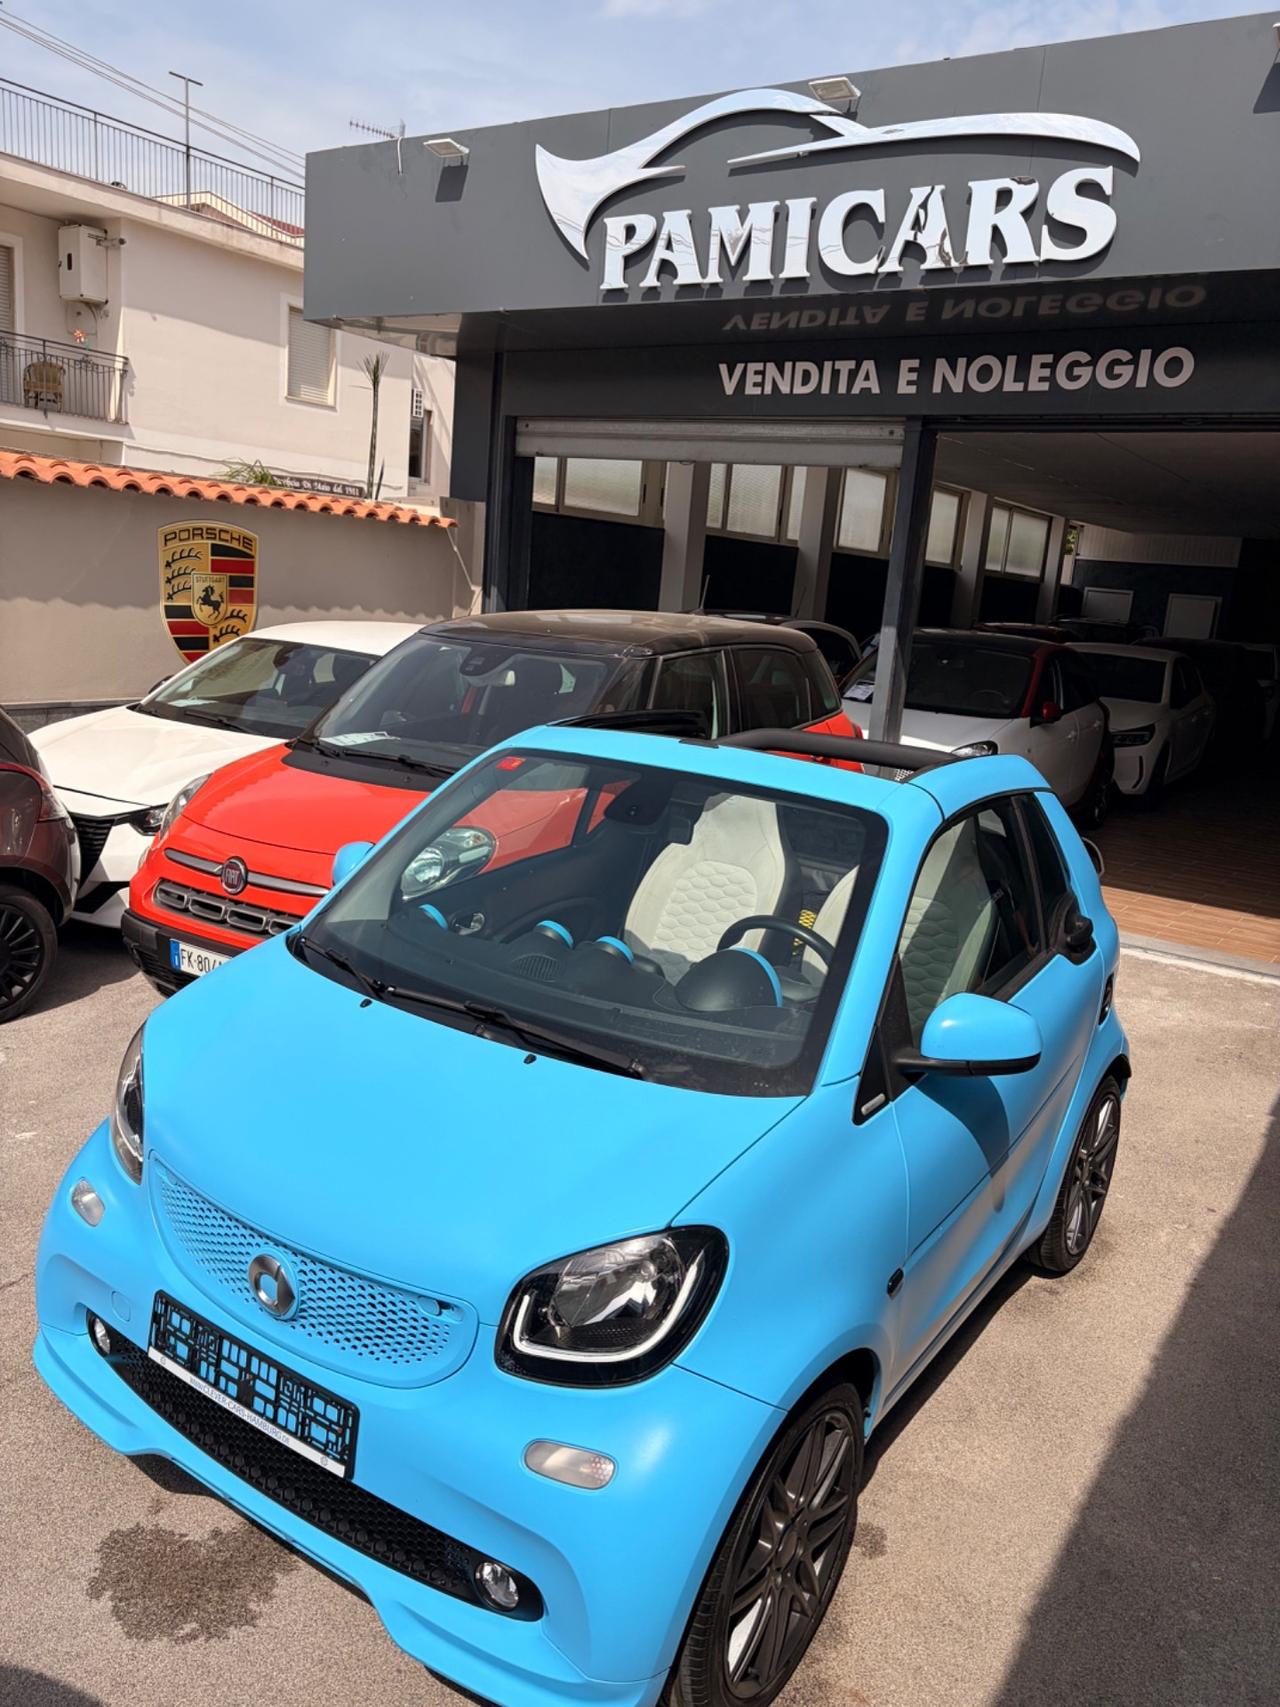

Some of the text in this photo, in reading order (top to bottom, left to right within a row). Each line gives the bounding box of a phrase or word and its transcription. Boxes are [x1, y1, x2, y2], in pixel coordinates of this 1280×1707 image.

[599, 166, 1118, 290] PAMICARS
[719, 346, 1195, 395] VENDITA E NOLEGGIO
[164, 527, 254, 551] PORSCHE
[226, 868, 240, 885] FIAT
